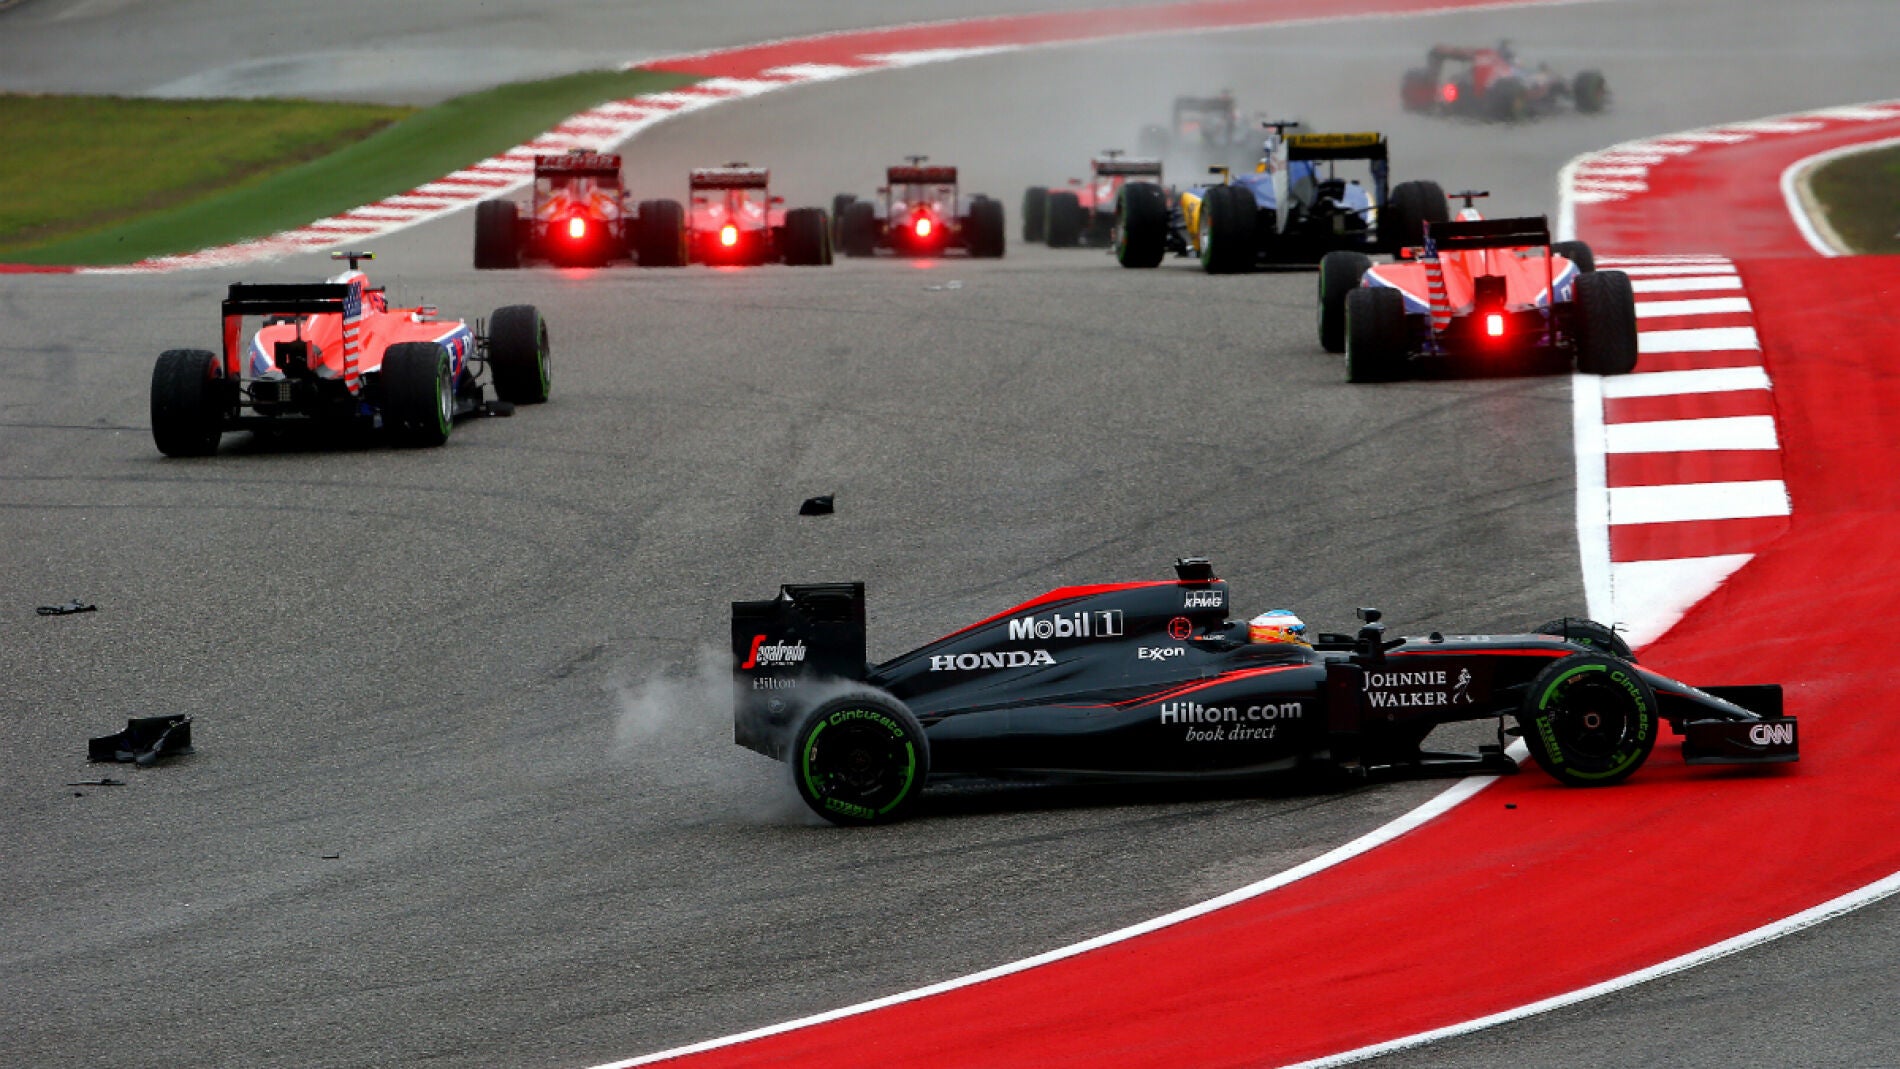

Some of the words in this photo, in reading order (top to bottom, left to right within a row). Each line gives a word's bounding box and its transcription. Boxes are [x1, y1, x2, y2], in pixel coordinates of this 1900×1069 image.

[1184, 597, 1223, 609] KPMG
[1009, 612, 1090, 641] Mobil
[741, 634, 807, 669] Segafredo
[929, 649, 1057, 671] HONDA
[1138, 647, 1185, 661] Exxon
[753, 677, 796, 690] Hilton
[1362, 671, 1447, 692] JOHNNIE
[1367, 691, 1448, 708] WALKER
[1161, 701, 1302, 724] Hilton.com
[1185, 726, 1225, 741] book
[1228, 723, 1276, 741] direct
[1750, 723, 1793, 745] CNN
